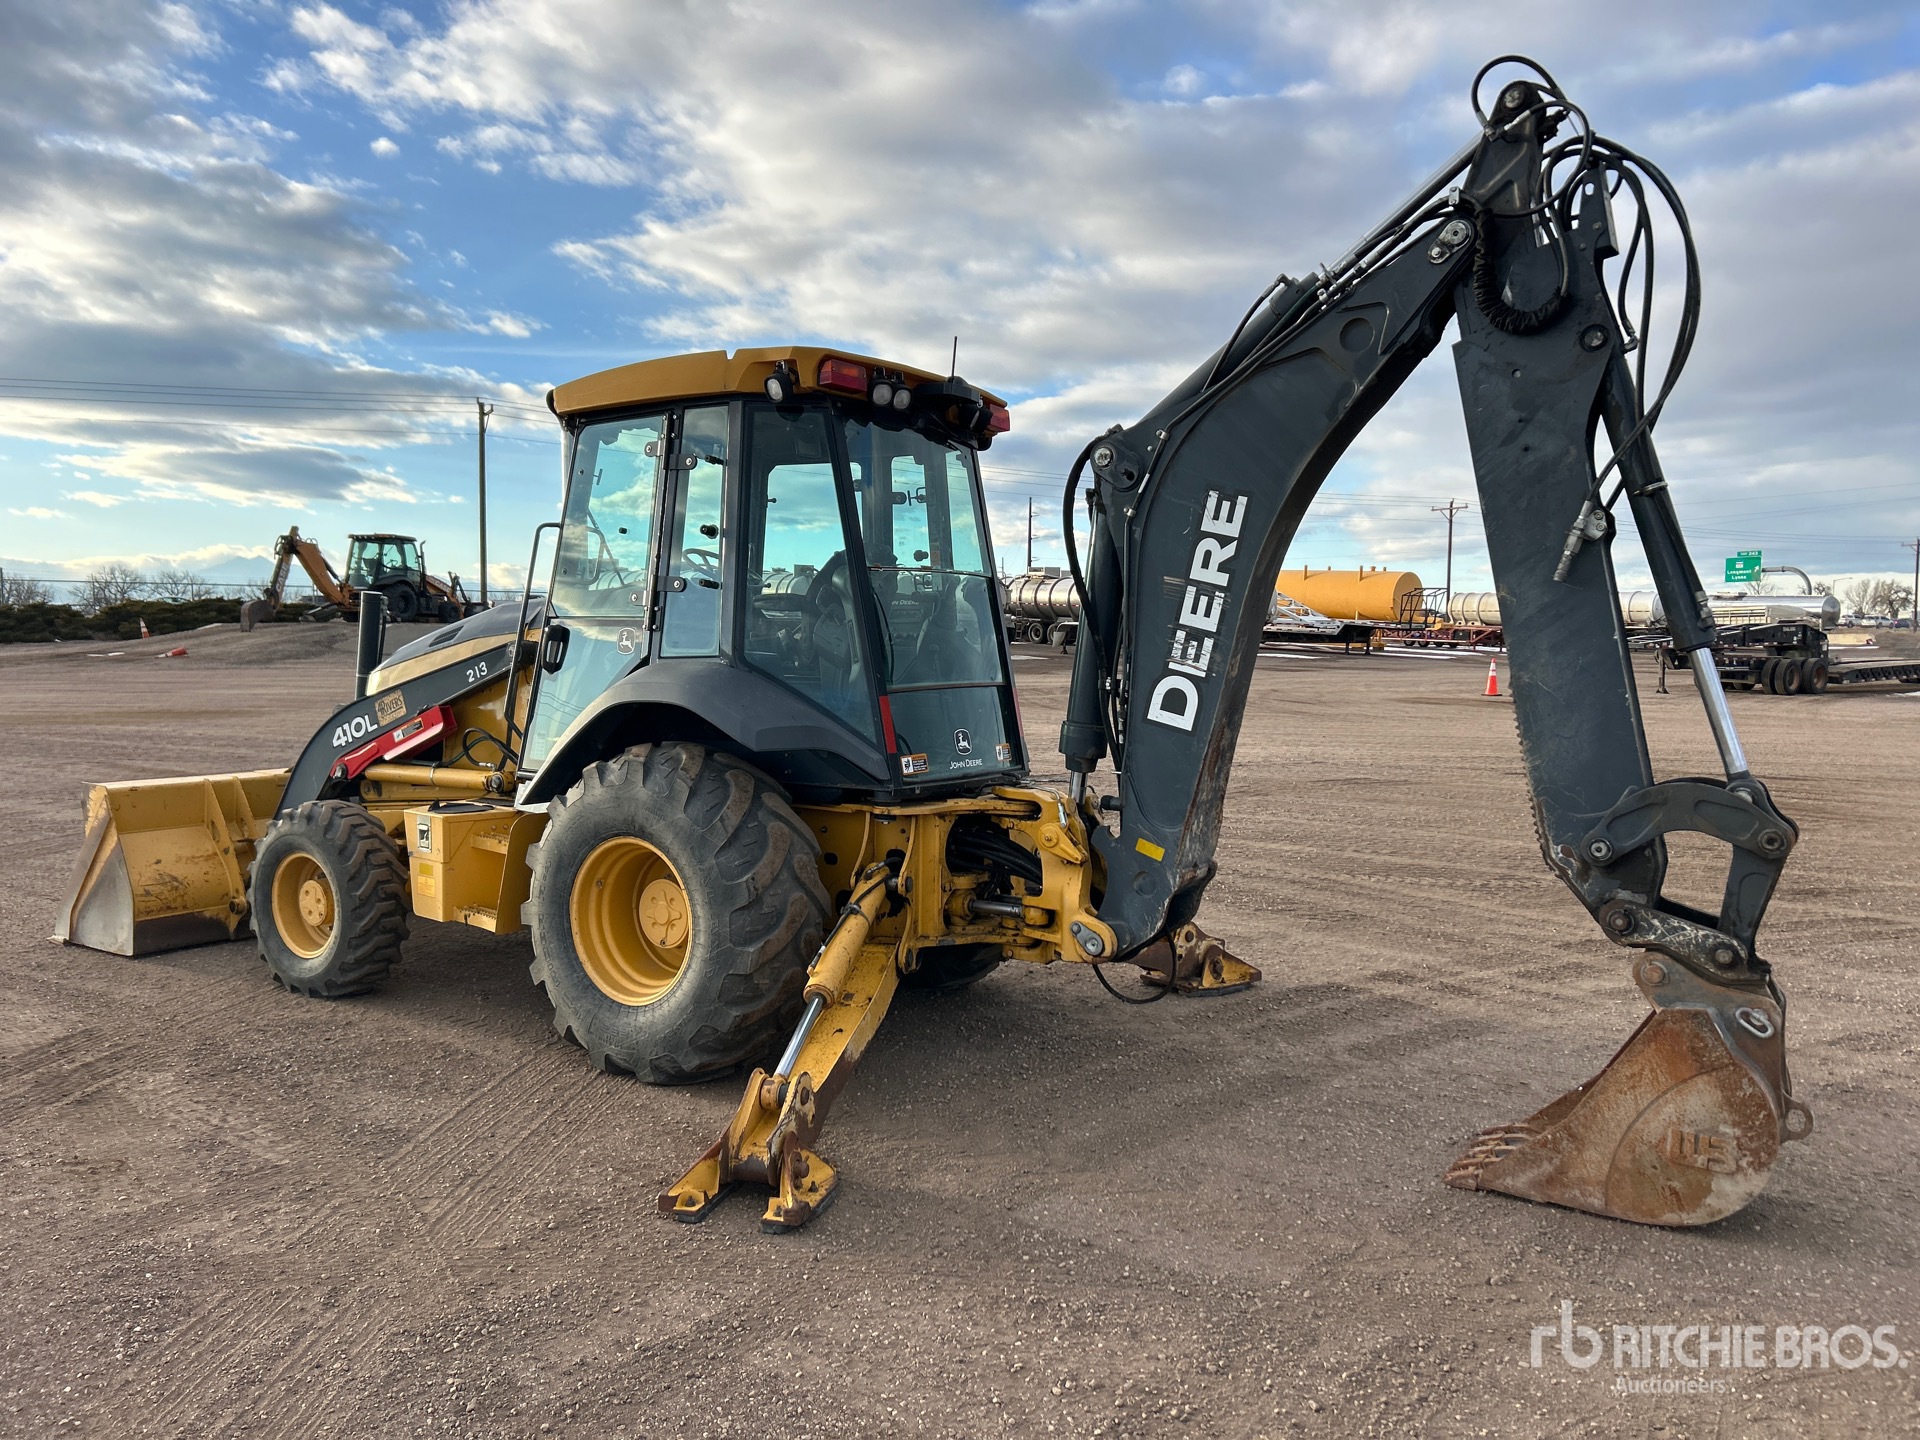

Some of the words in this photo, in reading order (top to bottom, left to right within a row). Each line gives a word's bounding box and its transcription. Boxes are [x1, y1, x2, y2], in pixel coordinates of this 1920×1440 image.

[1146, 490, 1249, 732] DEERE
[466, 661, 488, 683] 213
[332, 714, 378, 748] 410L
[949, 759, 966, 770] JOHN
[965, 758, 983, 768] DEERE
